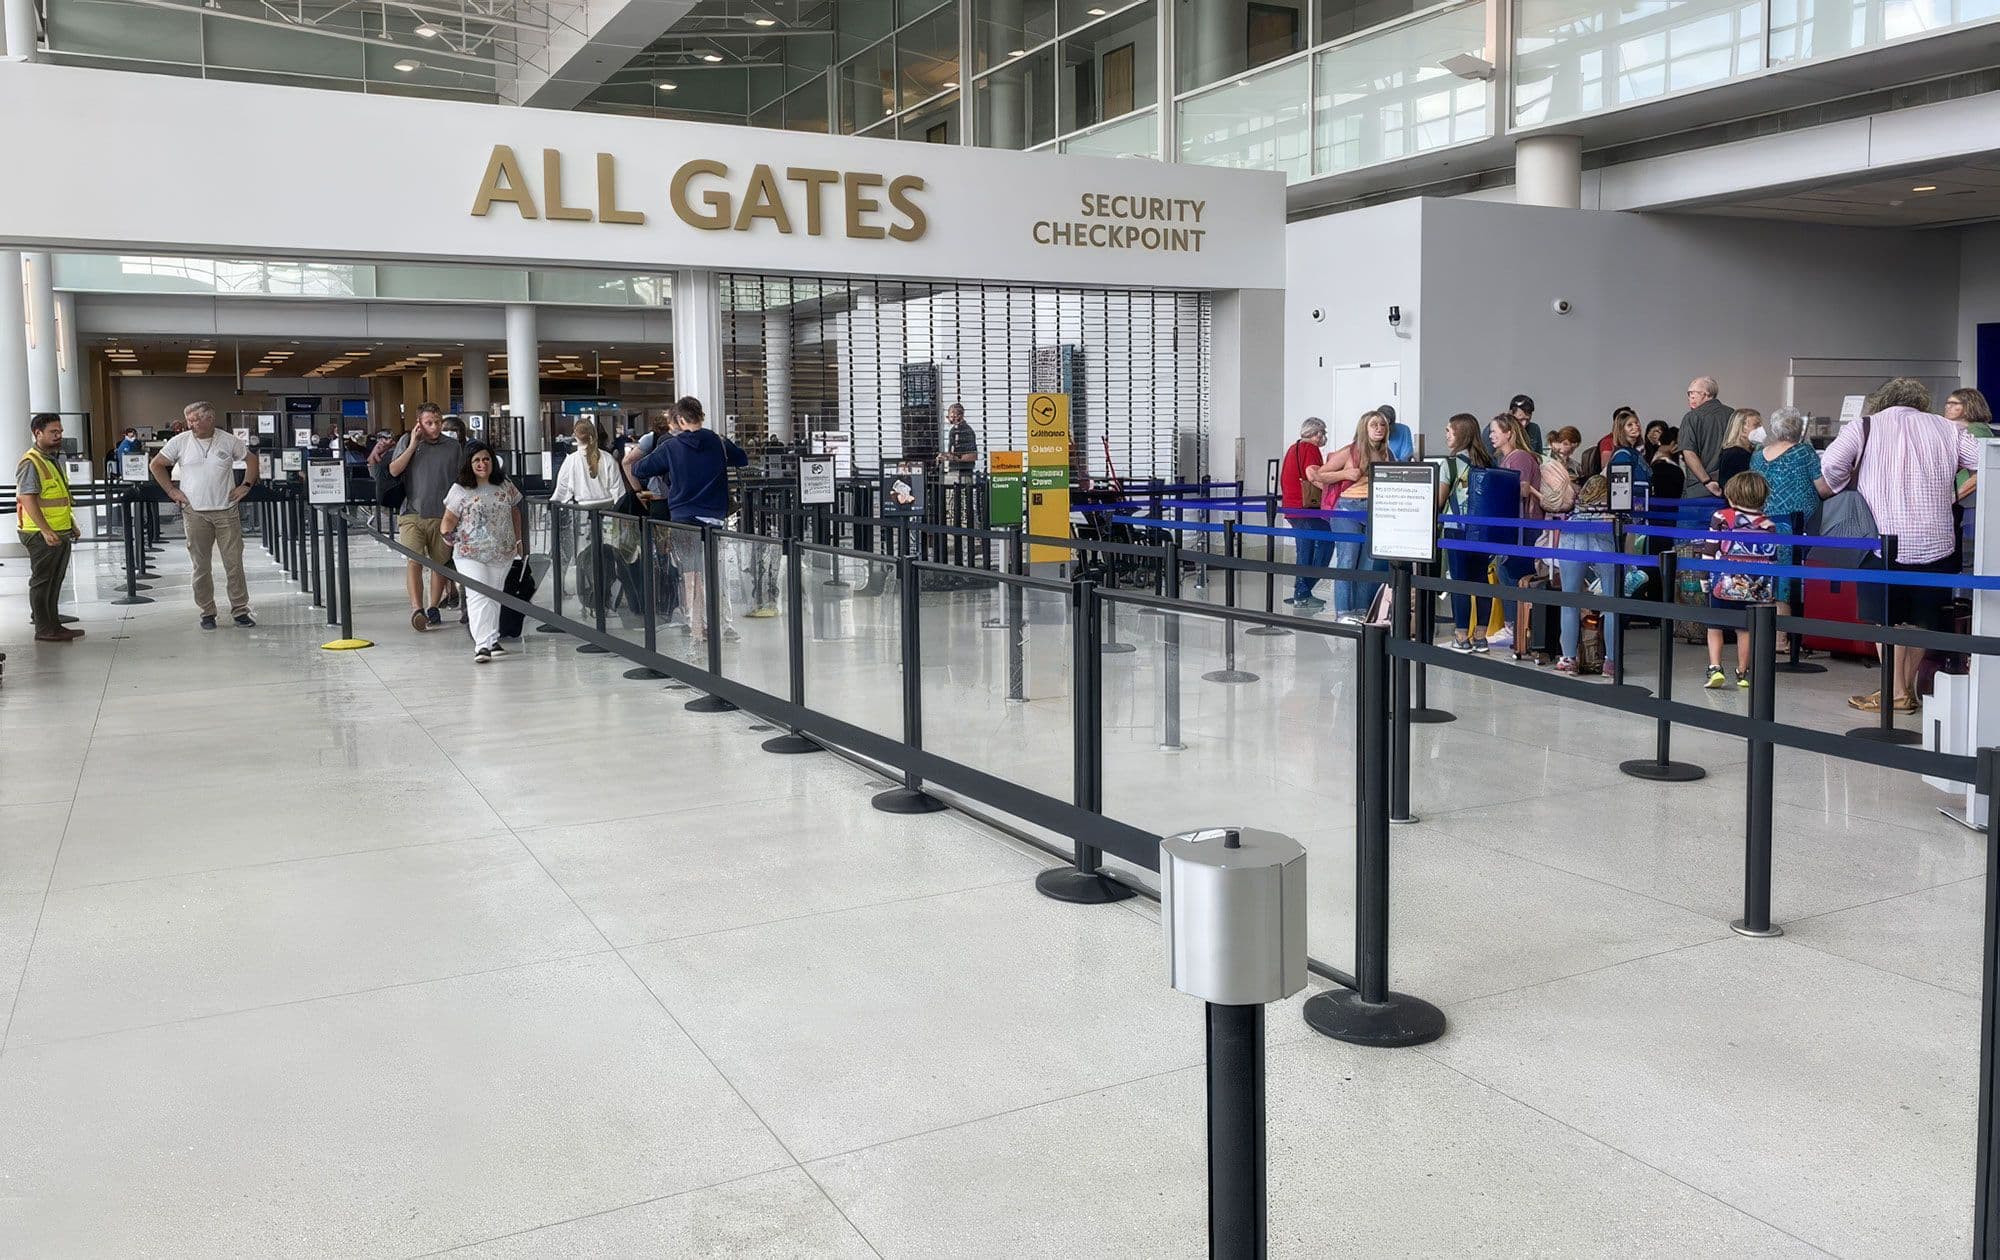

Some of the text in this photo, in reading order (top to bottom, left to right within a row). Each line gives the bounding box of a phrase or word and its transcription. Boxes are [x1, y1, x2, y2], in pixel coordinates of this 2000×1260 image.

[471, 144, 928, 242] ALL GATES
[1081, 192, 1206, 223] SECURITY
[1032, 221, 1206, 252] CHECKPOINT
